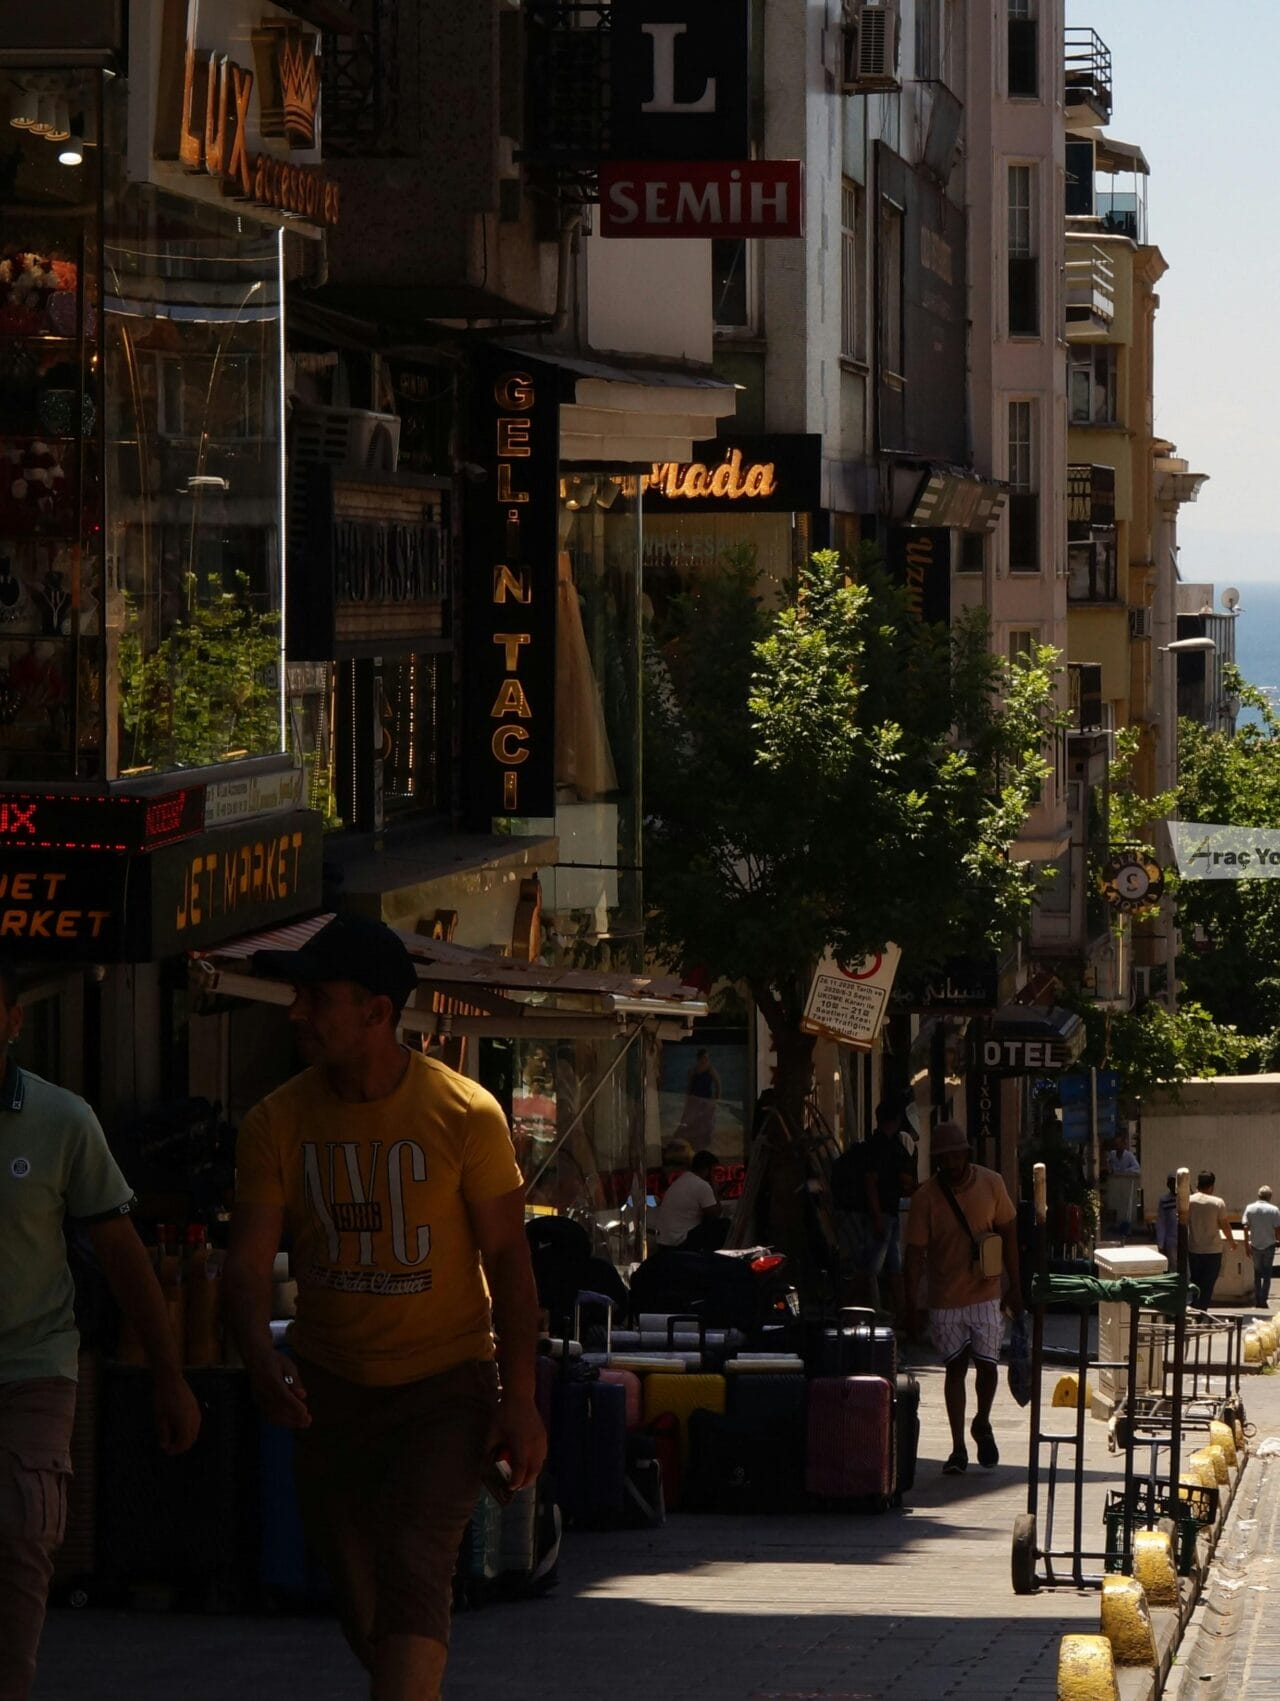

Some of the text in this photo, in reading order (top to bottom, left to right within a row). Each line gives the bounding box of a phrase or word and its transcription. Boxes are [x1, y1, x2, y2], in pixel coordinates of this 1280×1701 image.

[179, 48, 254, 192] LUX
[490, 632, 533, 811] TACI
[176, 831, 304, 931] JET MARKET
[301, 1139, 432, 1267] NYC
